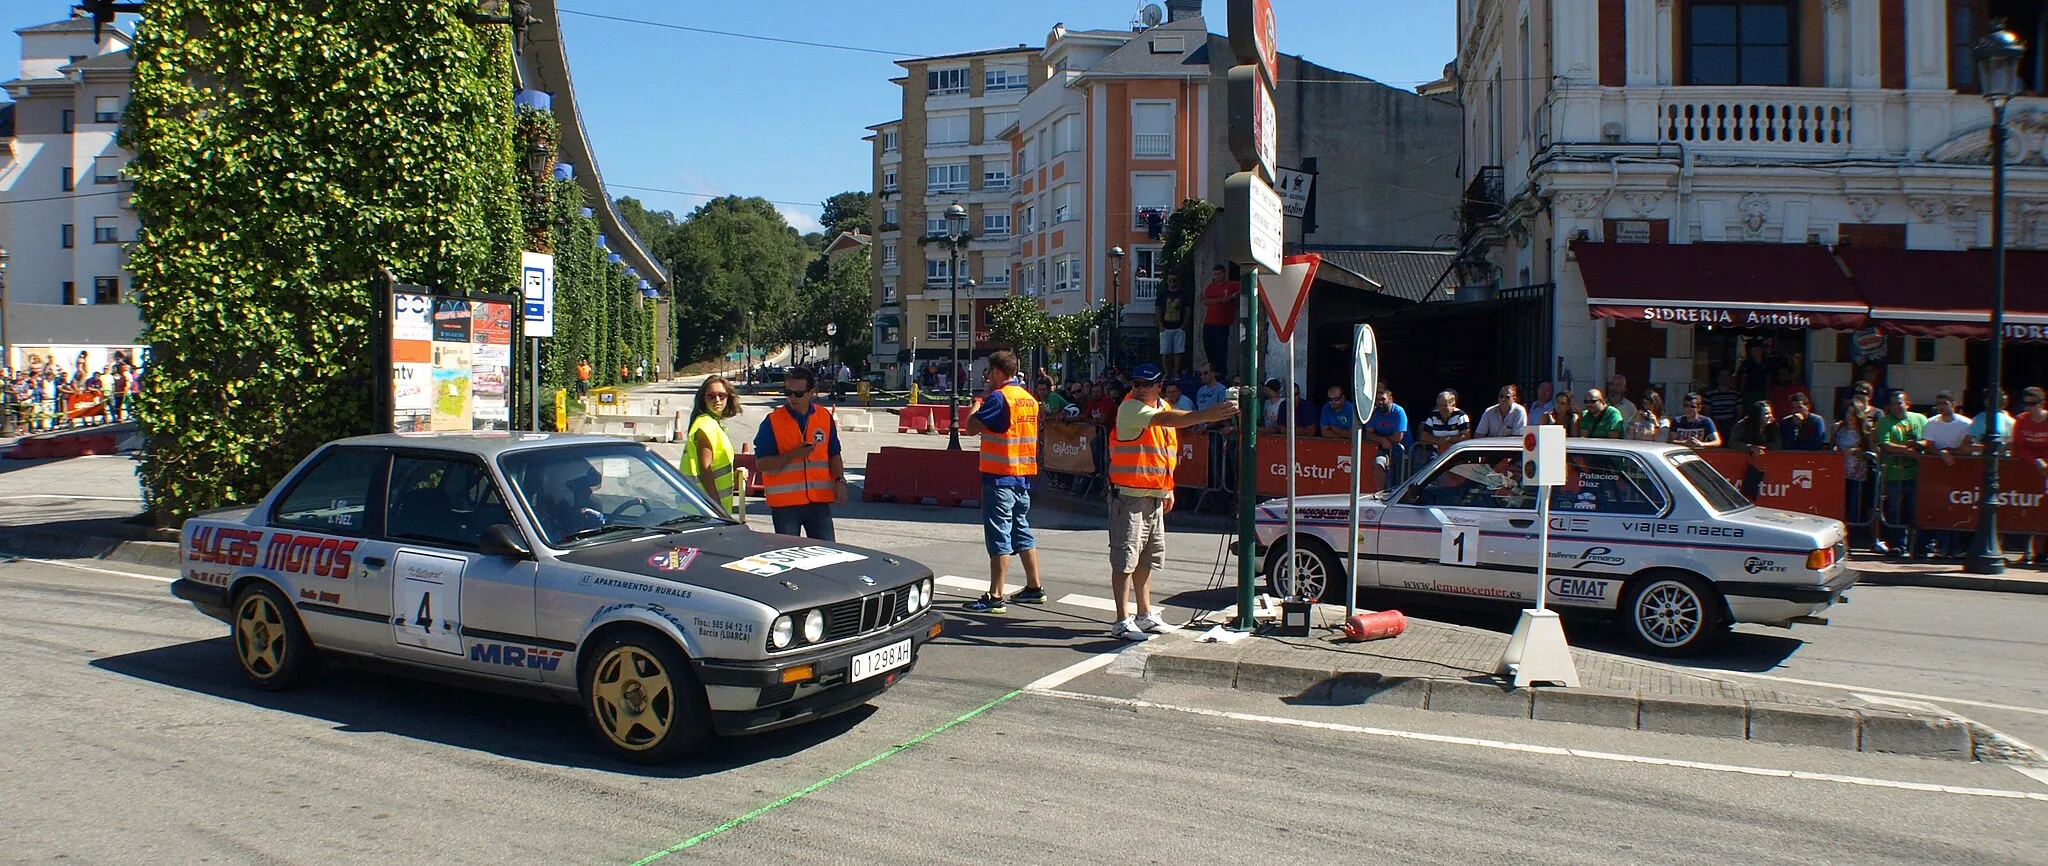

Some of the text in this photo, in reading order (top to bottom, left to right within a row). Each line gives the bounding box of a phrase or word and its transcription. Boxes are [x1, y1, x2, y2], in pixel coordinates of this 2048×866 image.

[1270, 462, 1336, 480] caAstur
[1580, 472, 1619, 481] Palacios
[1949, 486, 2044, 509] cajstur
[262, 532, 359, 580] MOTOS
[1453, 531, 1466, 562] 1
[1548, 551, 1578, 560] talleres
[594, 577, 693, 599] APARTAMENTOS RURALES
[1403, 580, 1521, 599] www.lemanscenter.es
[1547, 578, 1608, 600] CEMAT
[416, 591, 433, 634] 4
[698, 627, 751, 644] Barcia (LUARCA)
[735, 622, 743, 632] 12
[470, 643, 564, 672] MRW
[868, 648, 895, 673] 1298
[897, 642, 909, 662] AH
